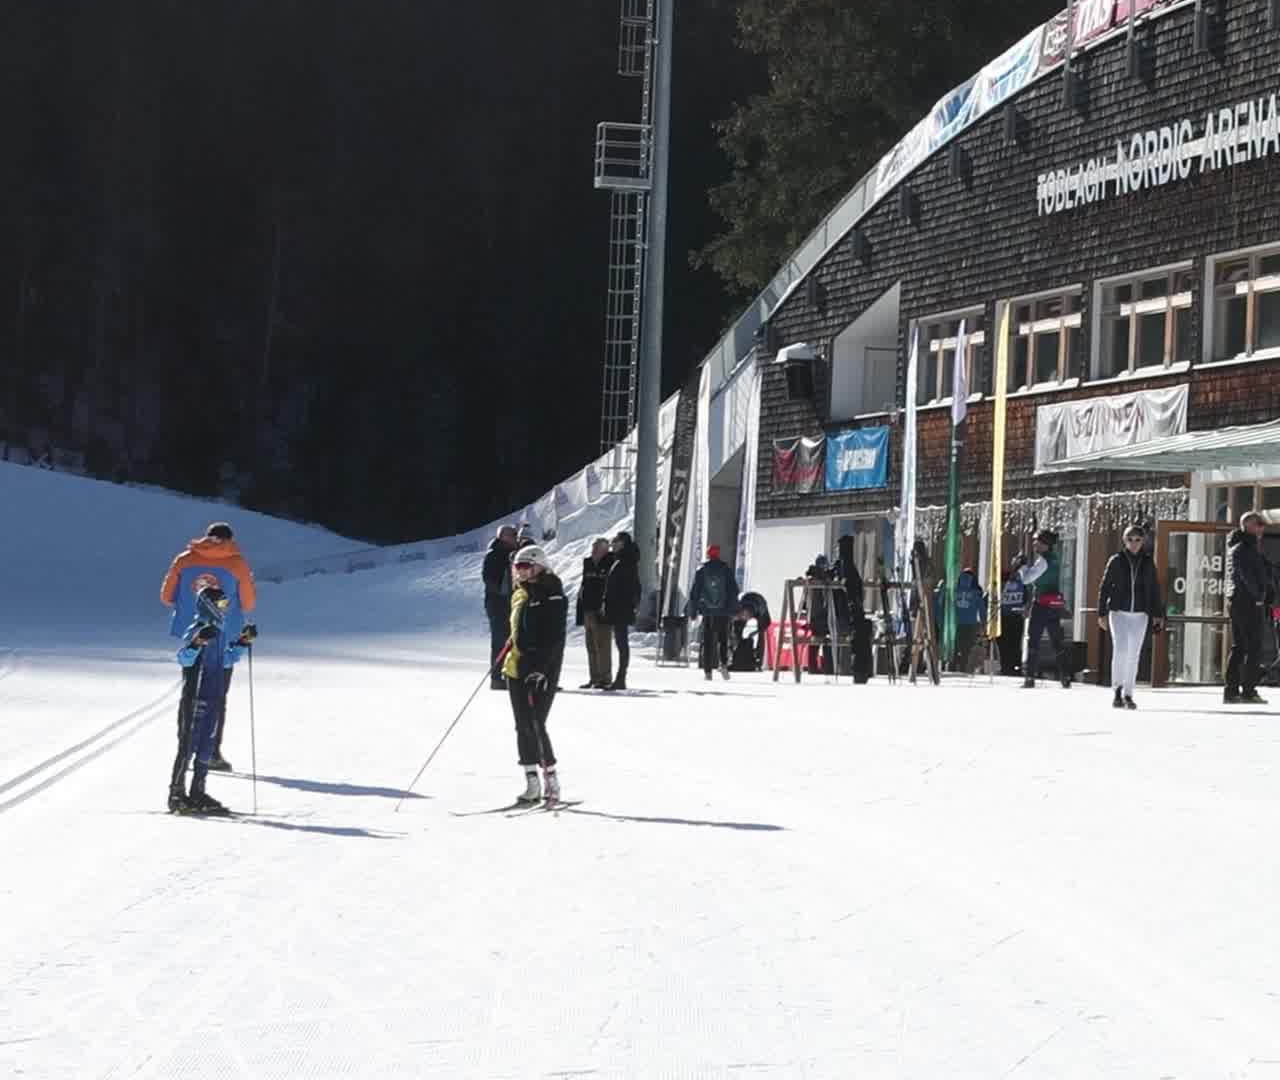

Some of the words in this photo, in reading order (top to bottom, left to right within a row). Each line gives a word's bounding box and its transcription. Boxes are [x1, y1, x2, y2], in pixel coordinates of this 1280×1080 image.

[1037, 156, 1107, 217] TOBLACH
[1114, 119, 1193, 196] NORDIC
[1200, 93, 1280, 173] ARENA
